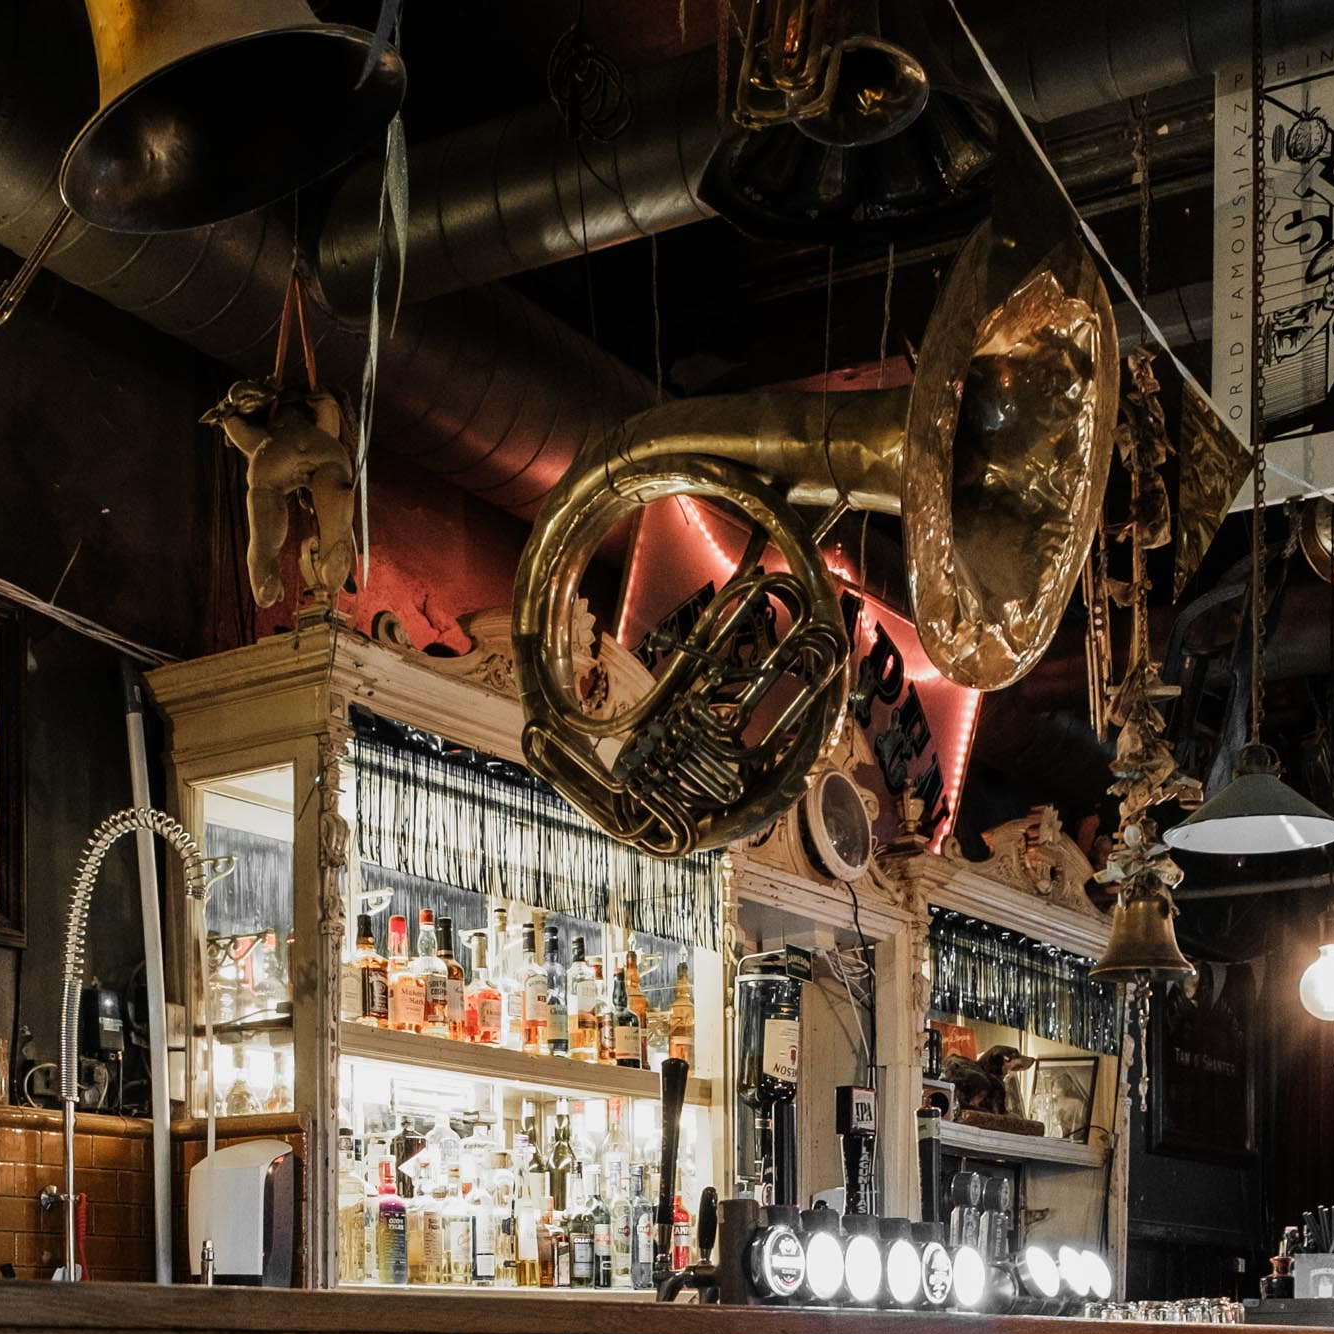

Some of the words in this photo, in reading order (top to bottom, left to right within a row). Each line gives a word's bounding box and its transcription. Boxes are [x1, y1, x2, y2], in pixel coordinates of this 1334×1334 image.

[1305, 50, 1334, 69] IN
[1232, 98, 1255, 192] JAZZ
[1230, 195, 1246, 321] FAMOUS
[1229, 342, 1244, 421] ORLD
[855, 1101, 874, 1123] IPA
